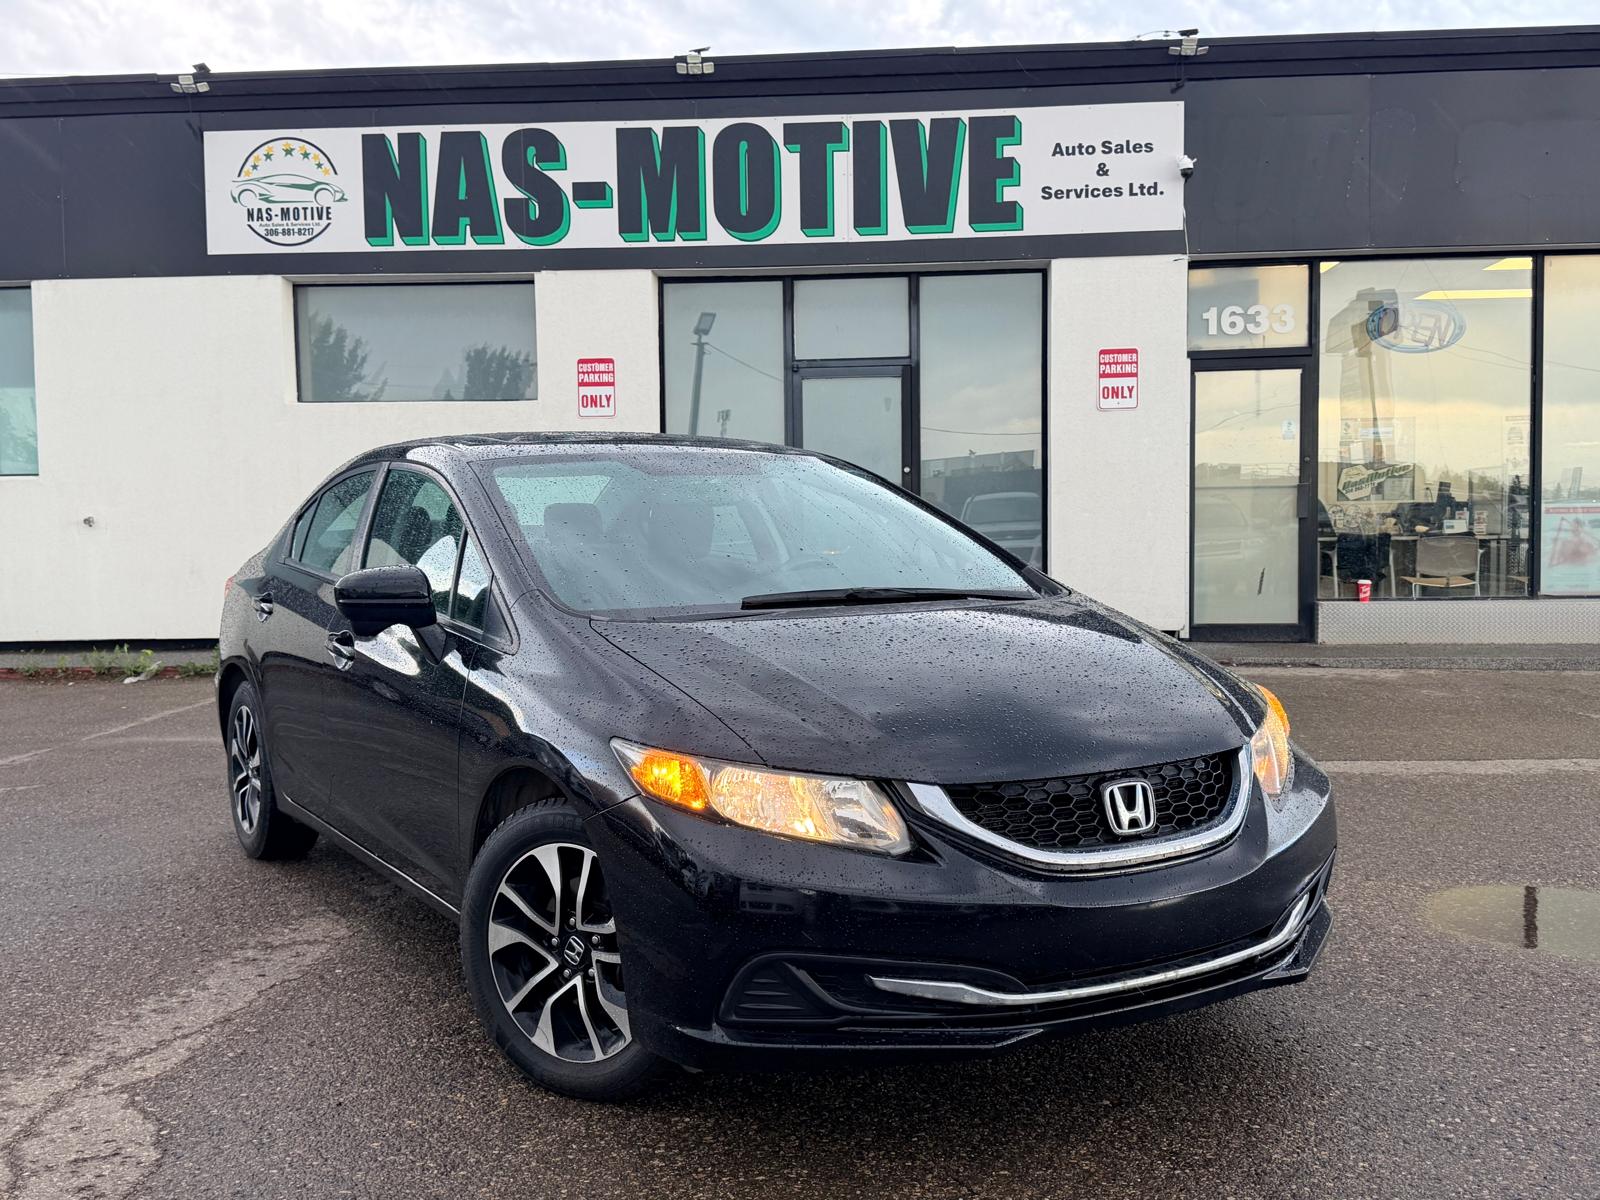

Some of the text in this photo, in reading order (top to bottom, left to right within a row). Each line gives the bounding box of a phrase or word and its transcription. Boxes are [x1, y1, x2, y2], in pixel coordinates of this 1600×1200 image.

[1051, 139, 1154, 157] Auto Sales
[1096, 162, 1110, 177] &
[361, 114, 1023, 248] NAS-MOTIVE
[1041, 181, 1165, 200] Services Ltd.
[247, 206, 332, 222] NAS-MOTIVE
[1202, 304, 1297, 336] 1633
[1100, 353, 1137, 363] CUSTOMER
[578, 363, 614, 372] CUSTOMER
[1100, 363, 1137, 374] PARKING
[578, 373, 614, 383] PARKING
[1102, 385, 1135, 400] ONLY
[581, 394, 612, 409] ONLY
